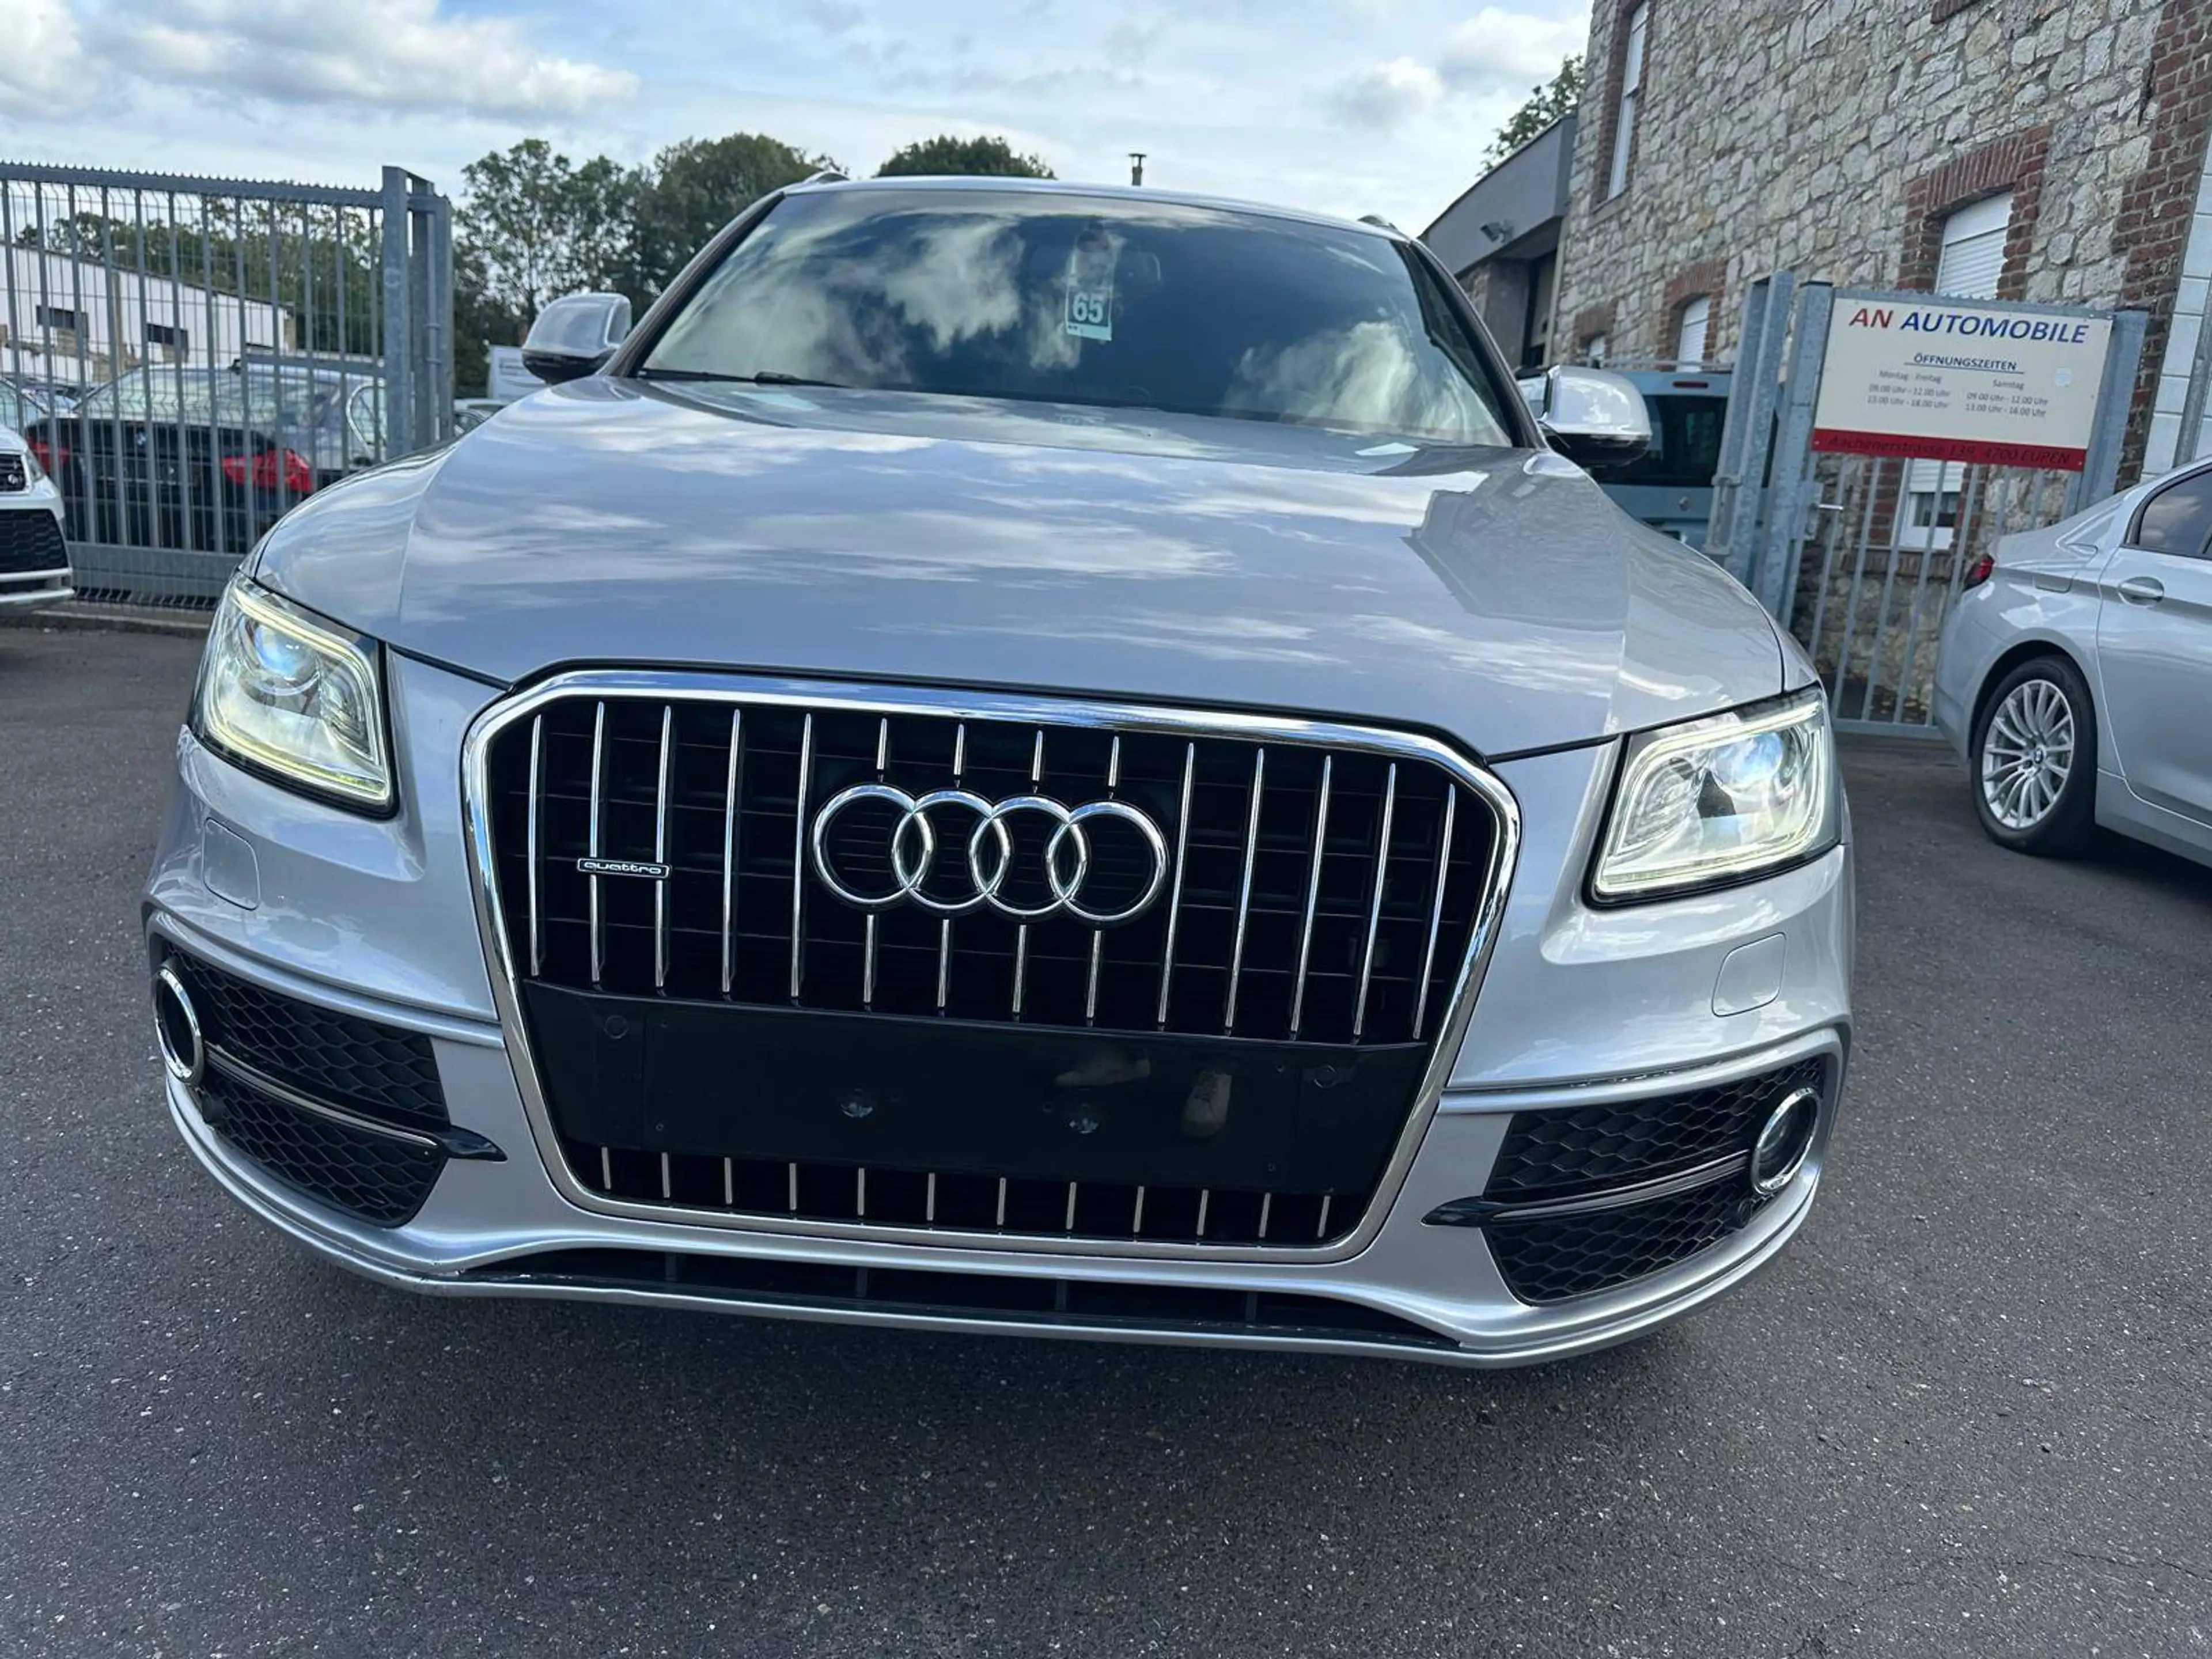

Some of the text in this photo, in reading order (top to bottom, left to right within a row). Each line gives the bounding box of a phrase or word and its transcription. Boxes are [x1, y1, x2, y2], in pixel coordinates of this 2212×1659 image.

[1073, 291, 1103, 323] 65
[1849, 308, 2089, 343] AN AUTOMOBILE
[1914, 353, 2017, 370] ÖFFNUNGSZEITEN
[584, 861, 661, 874] quattro
